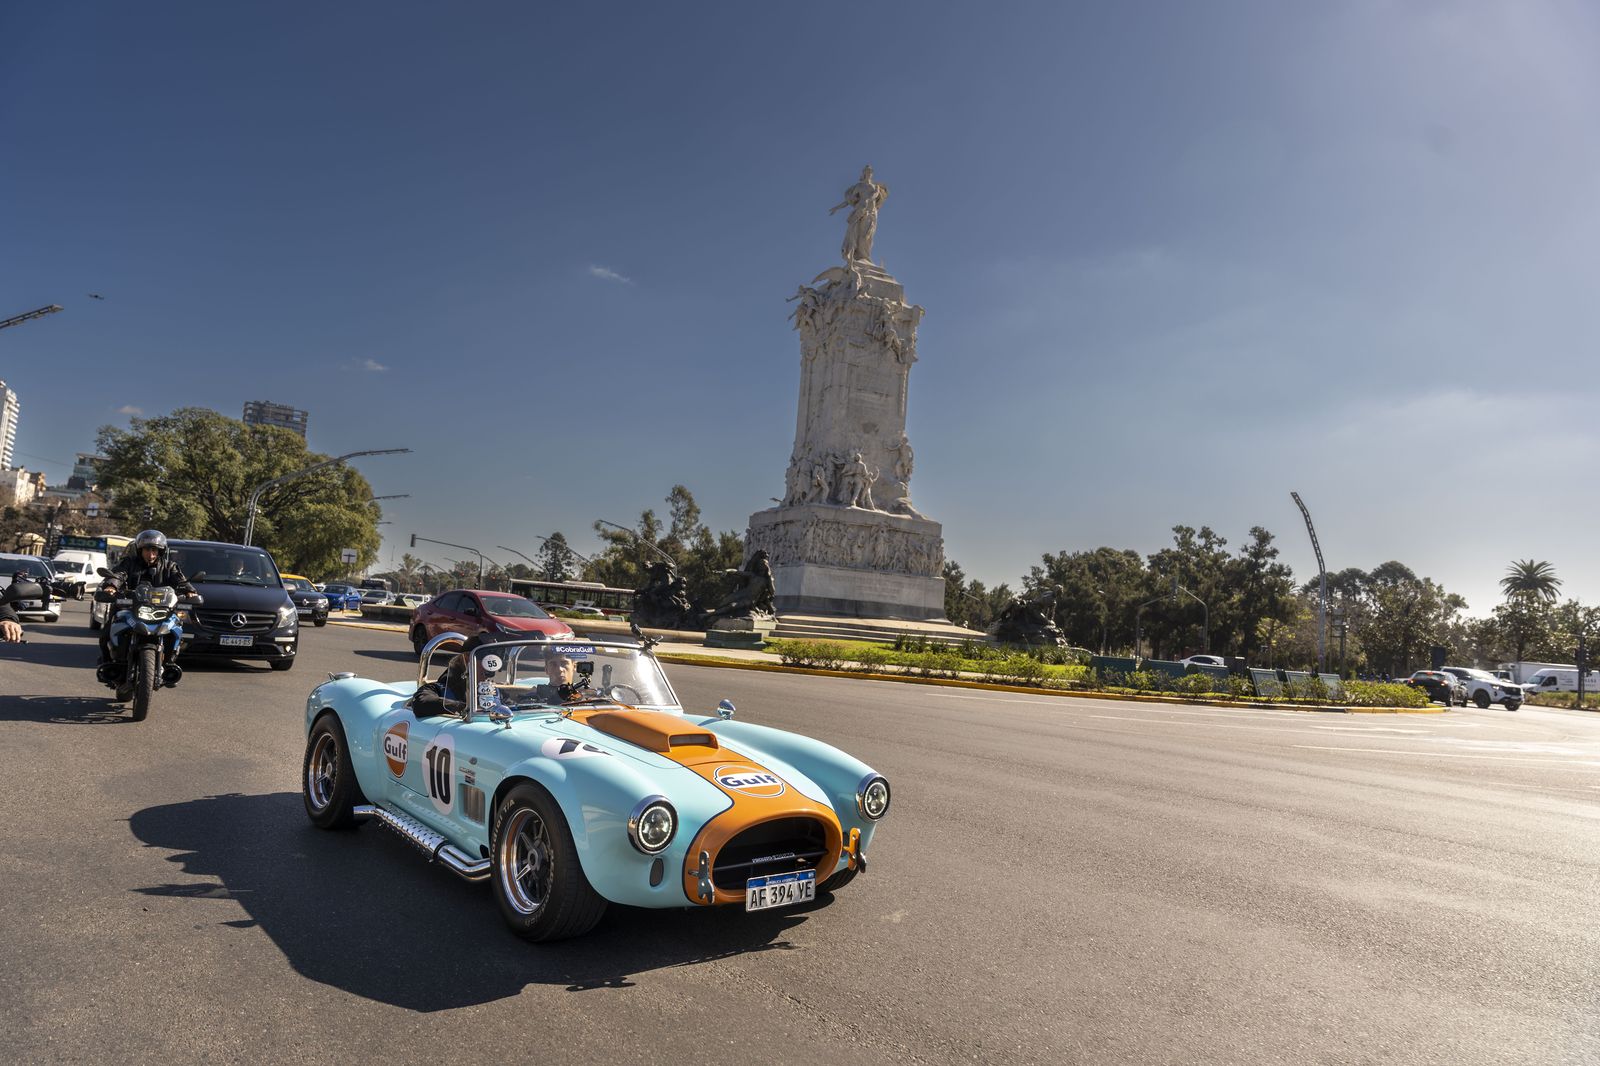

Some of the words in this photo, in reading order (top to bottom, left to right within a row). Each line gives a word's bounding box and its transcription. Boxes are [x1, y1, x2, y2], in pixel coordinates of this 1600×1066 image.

[487, 660, 497, 668] 55
[384, 736, 407, 760] Gulf
[426, 745, 451, 805] 10
[720, 774, 778, 787] Gulf
[751, 888, 767, 908] AF
[770, 884, 794, 904] 394
[798, 881, 813, 899] YE
